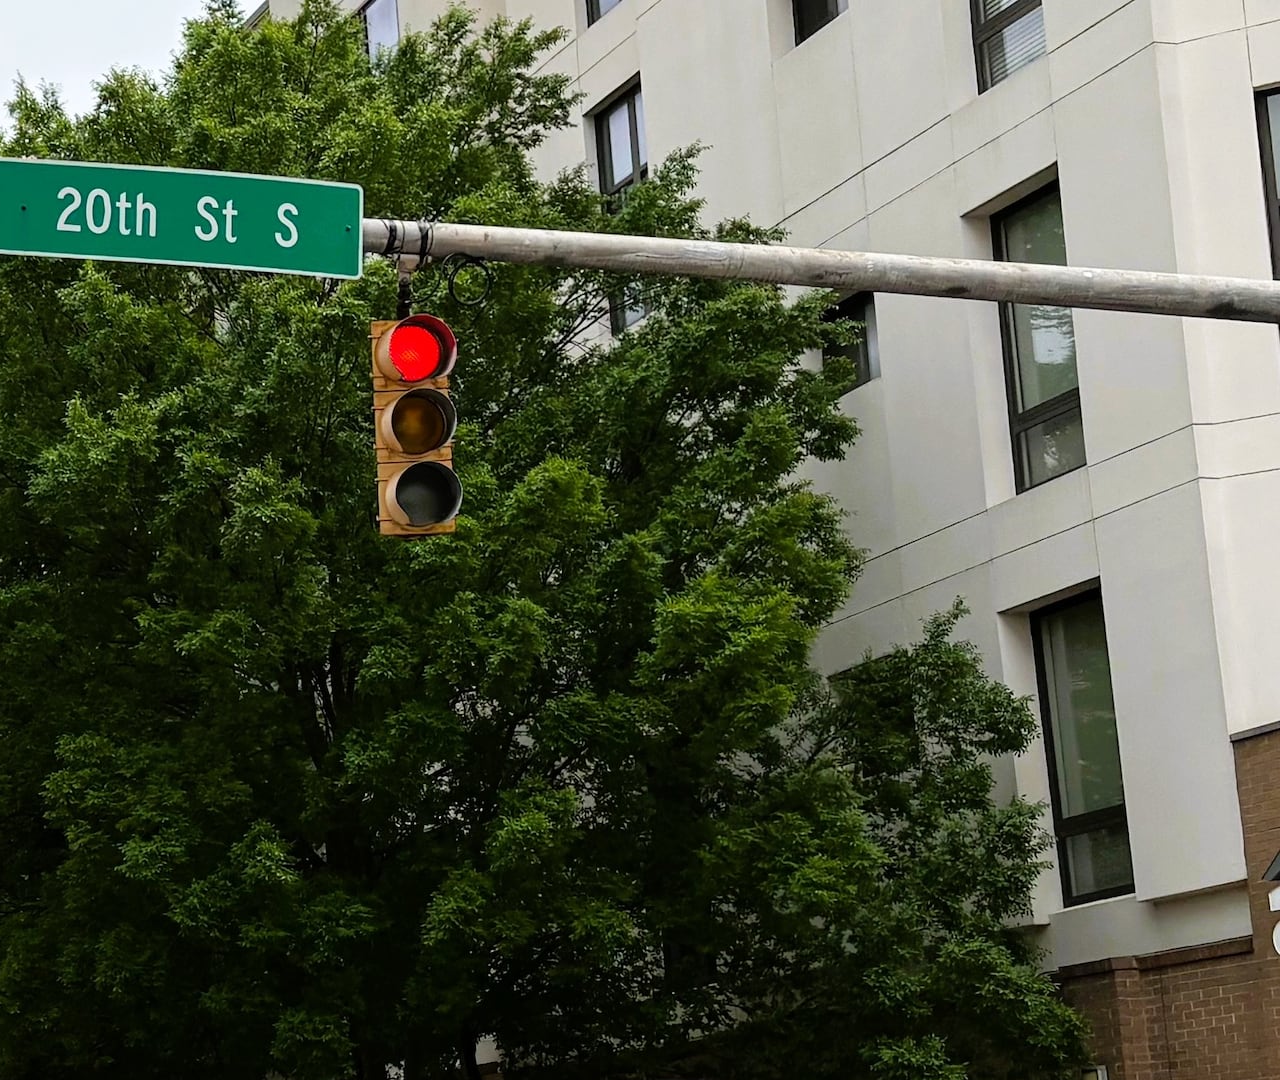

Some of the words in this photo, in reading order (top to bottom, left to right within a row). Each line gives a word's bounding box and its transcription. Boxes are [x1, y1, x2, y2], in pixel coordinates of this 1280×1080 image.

[55, 187, 157, 238] 20th
[194, 196, 238, 243] St
[274, 202, 299, 248] S
